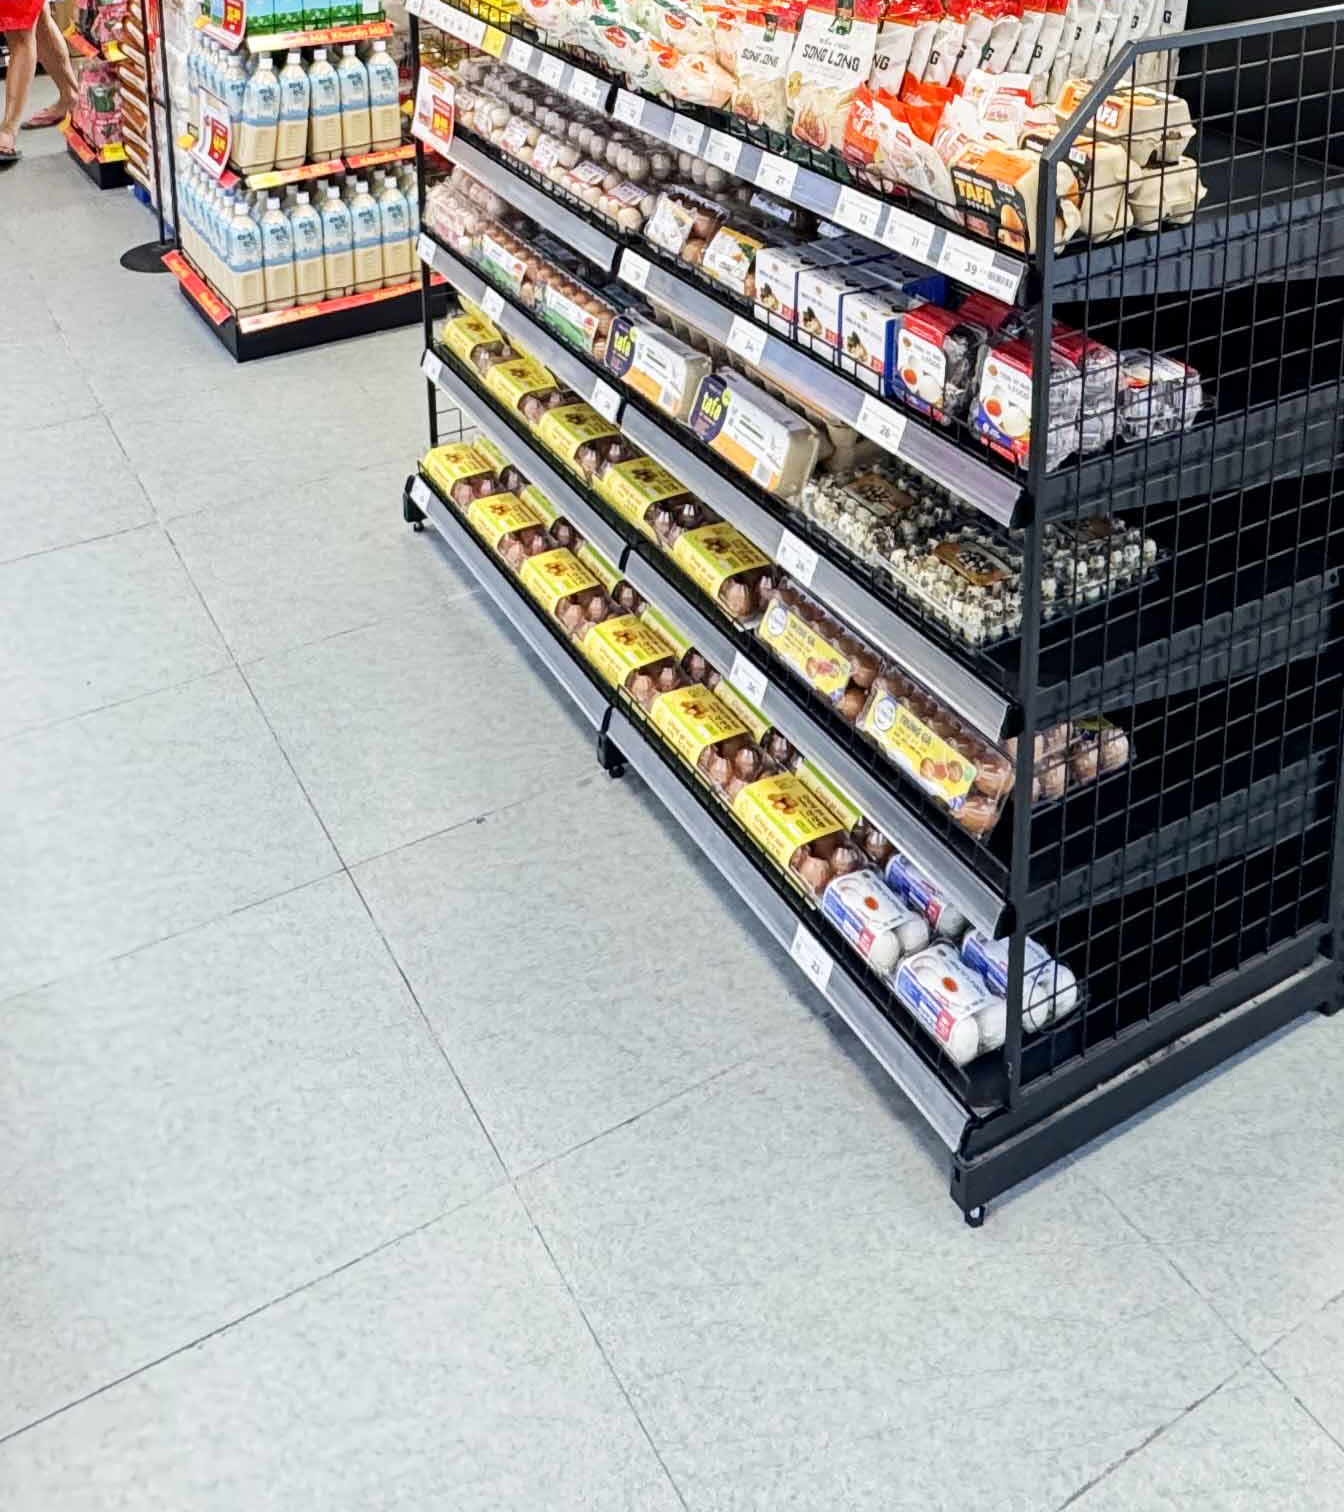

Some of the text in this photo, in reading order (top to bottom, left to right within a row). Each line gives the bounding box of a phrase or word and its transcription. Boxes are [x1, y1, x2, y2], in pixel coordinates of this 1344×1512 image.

[802, 43, 829, 63] SONG
[828, 50, 861, 73] LONG
[954, 178, 996, 209] TAFA
[700, 391, 722, 421] tafa
